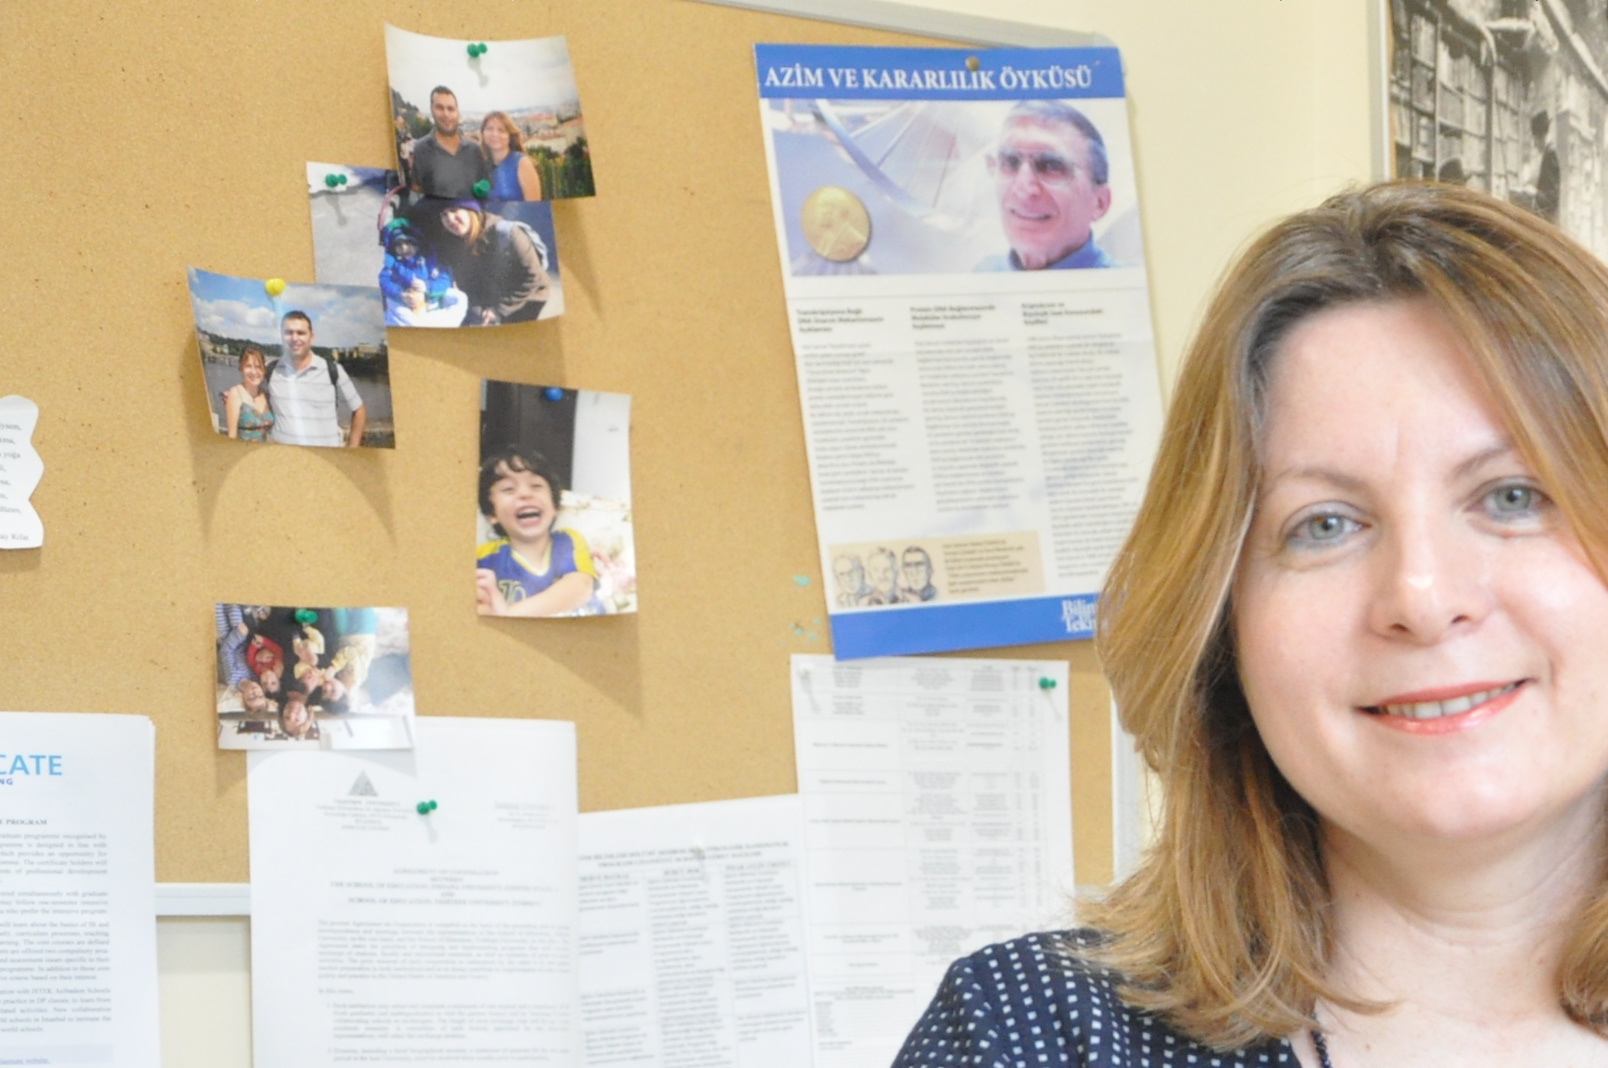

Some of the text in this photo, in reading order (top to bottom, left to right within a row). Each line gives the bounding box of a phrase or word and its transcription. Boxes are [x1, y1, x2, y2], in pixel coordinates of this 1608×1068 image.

[765, 63, 1092, 91] AZİM VE KARARLILIK ÖYKÜSÜ
